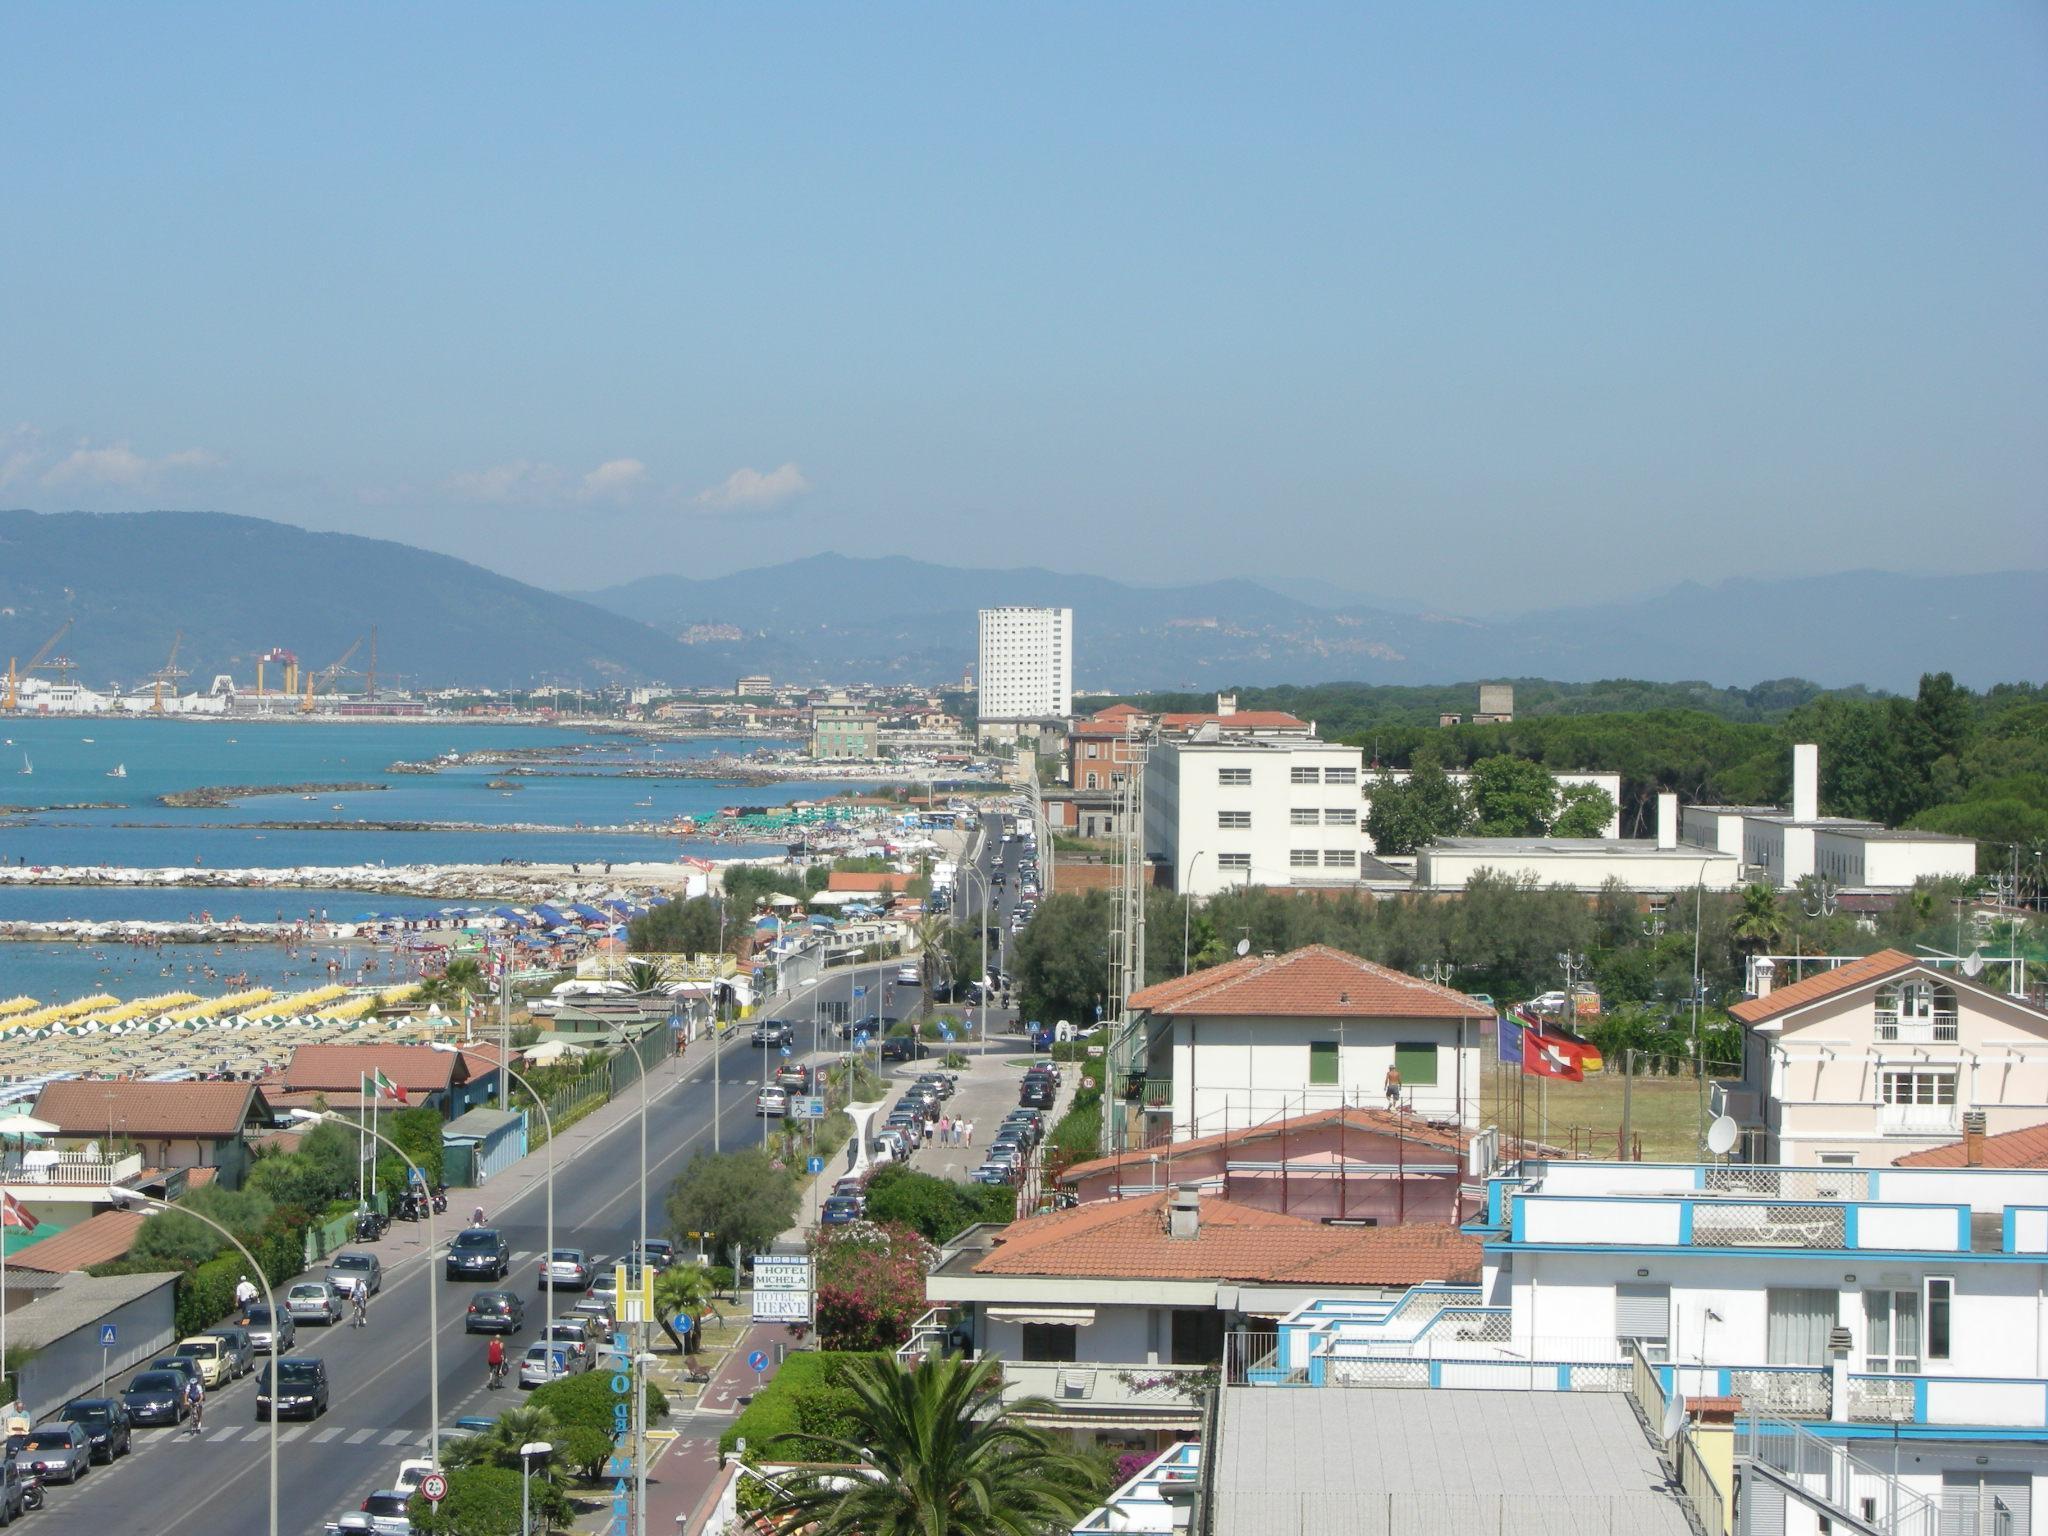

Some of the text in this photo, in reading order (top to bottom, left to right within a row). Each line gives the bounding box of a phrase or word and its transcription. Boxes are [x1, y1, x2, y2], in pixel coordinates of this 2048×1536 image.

[756, 1276, 806, 1284] MICHELA
[616, 1265, 654, 1323] H
[757, 1292, 794, 1302] HOTEL
